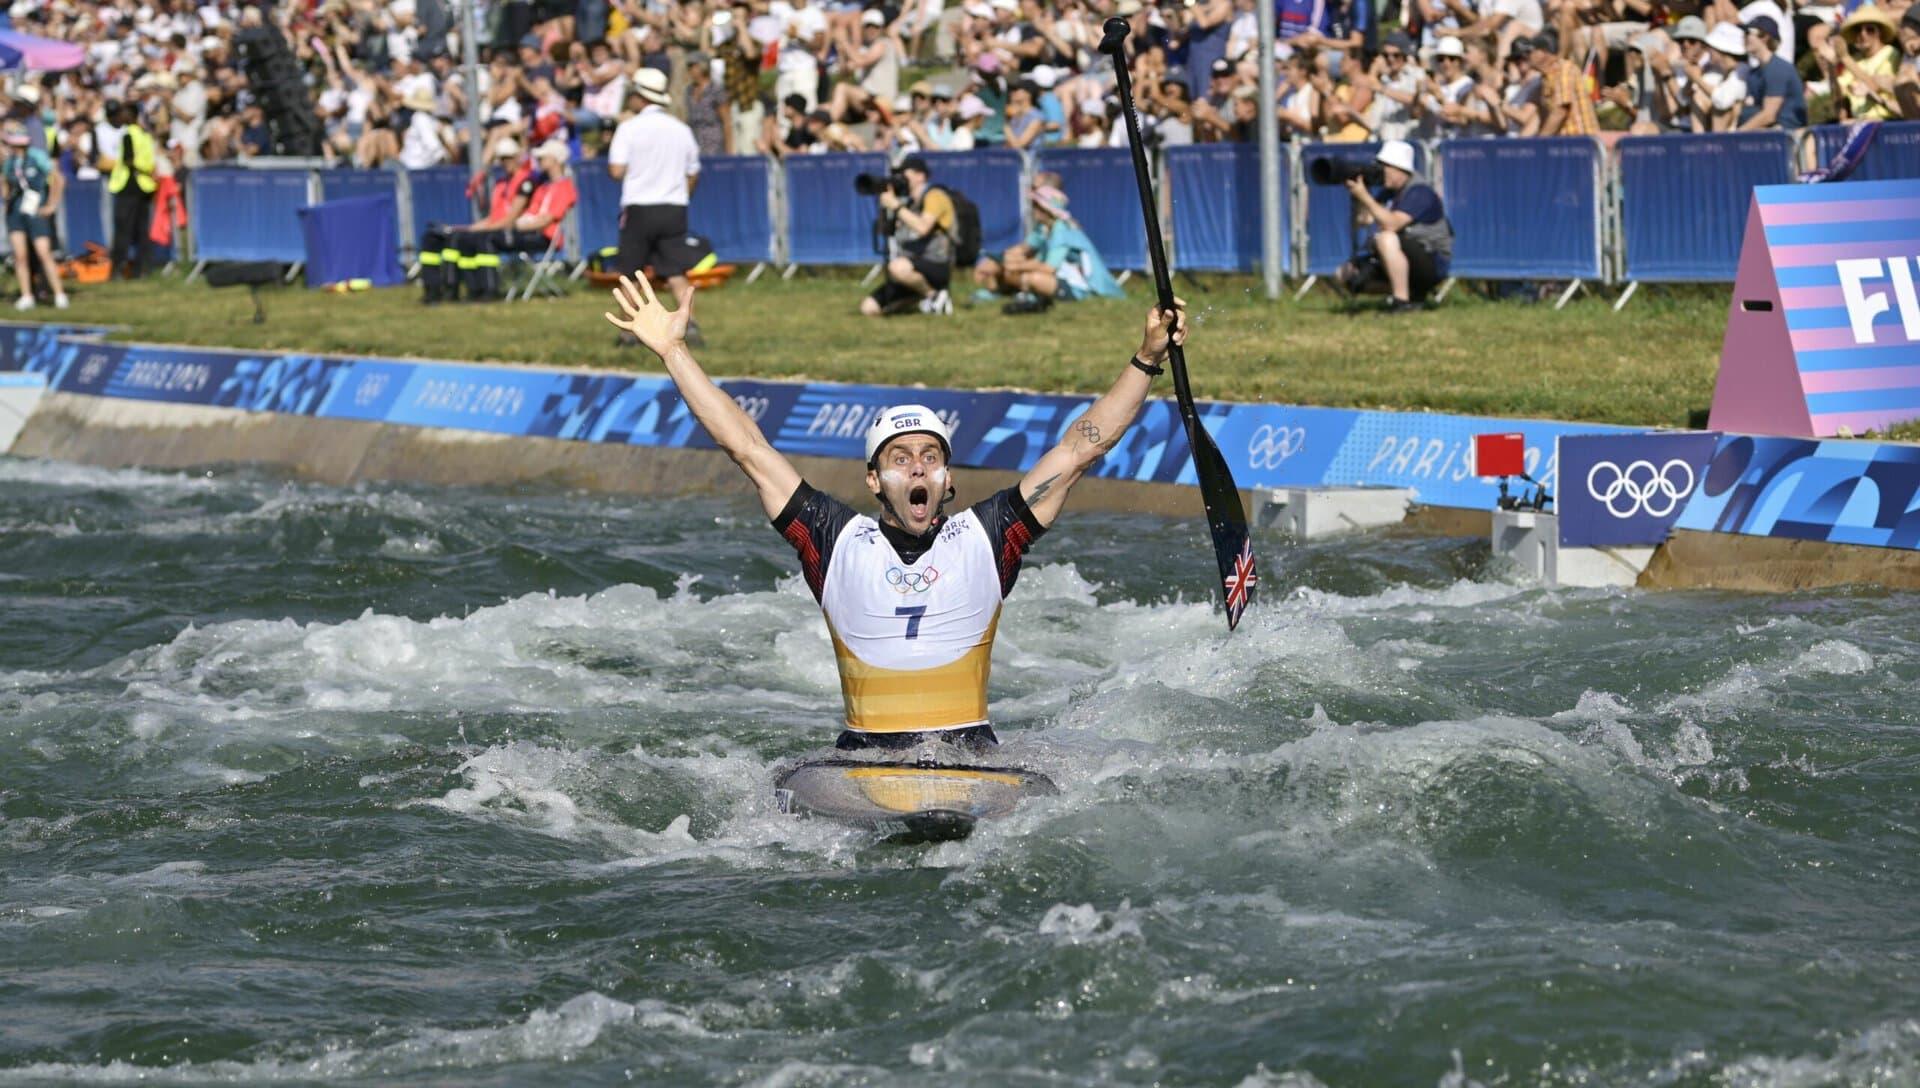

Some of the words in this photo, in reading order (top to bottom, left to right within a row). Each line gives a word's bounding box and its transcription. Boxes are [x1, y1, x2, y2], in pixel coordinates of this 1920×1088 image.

[1835, 255, 1920, 344] FI
[894, 418, 921, 429] GBR
[894, 604, 927, 640] 7
